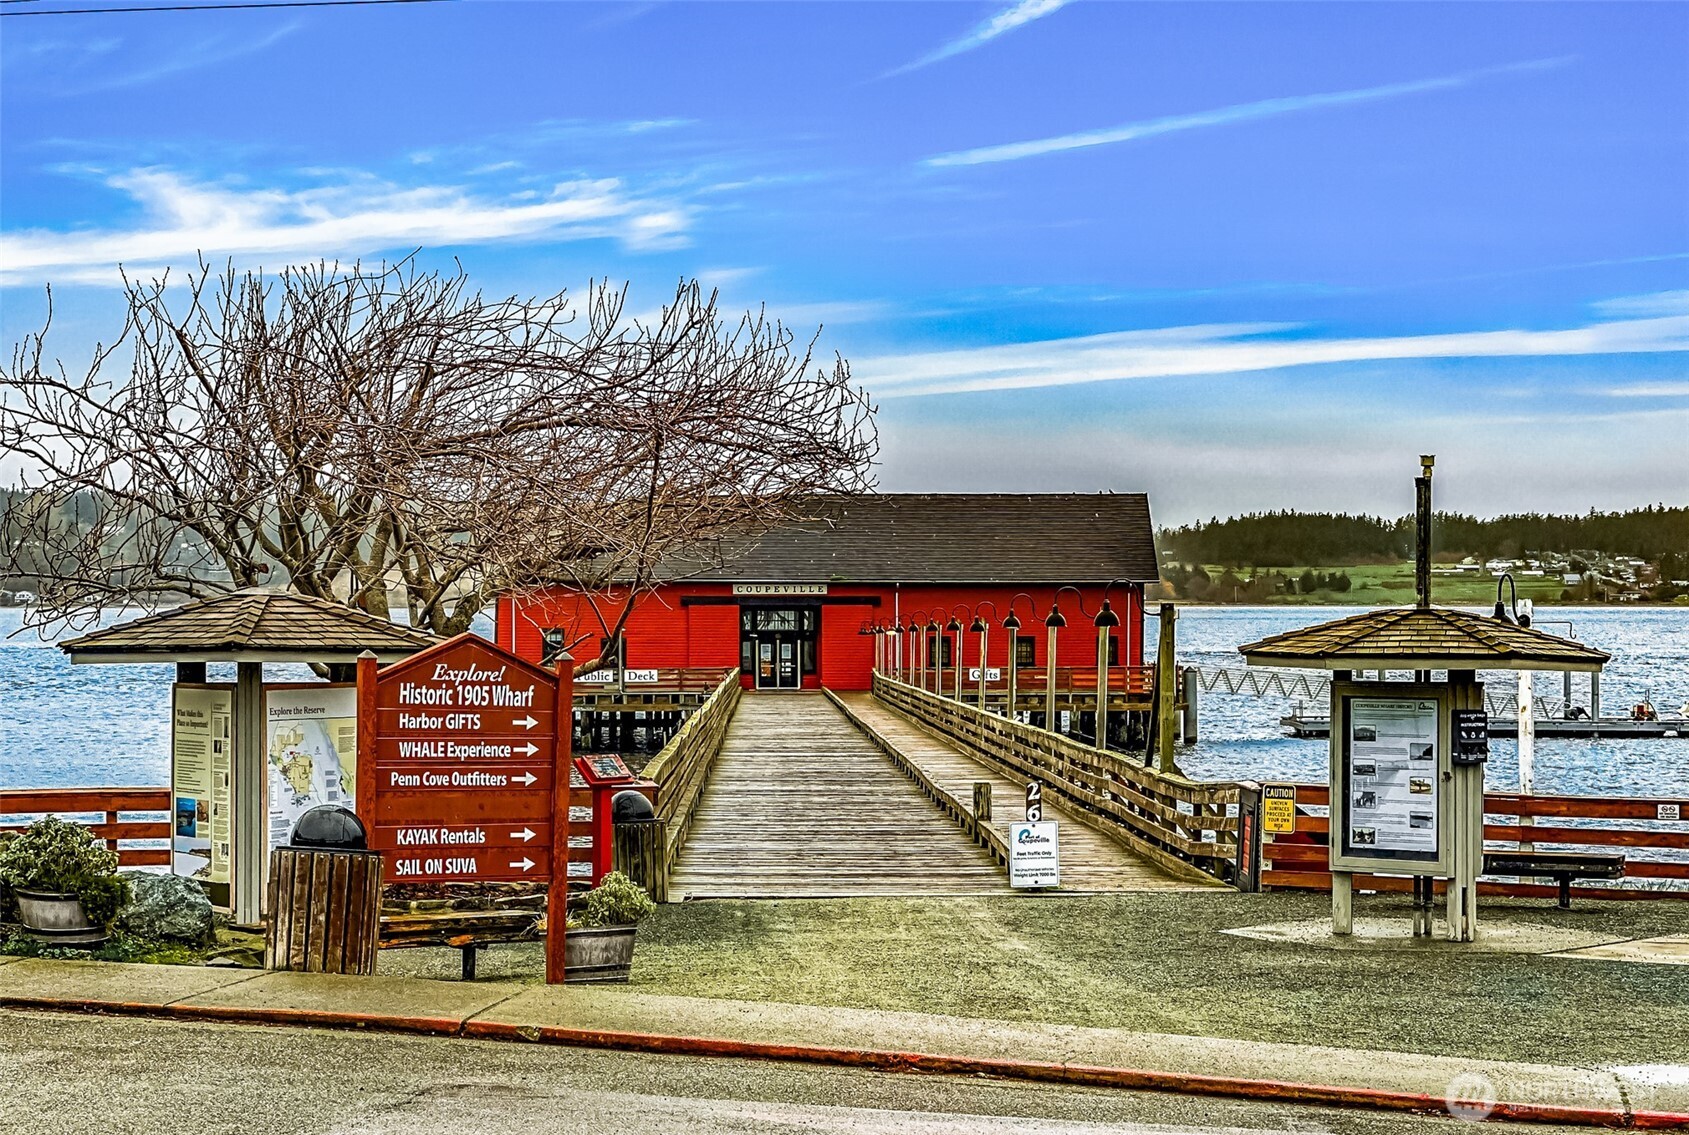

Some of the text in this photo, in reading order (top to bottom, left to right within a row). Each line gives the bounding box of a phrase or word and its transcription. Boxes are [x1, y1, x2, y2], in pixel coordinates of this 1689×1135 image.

[736, 585, 824, 594] COUPEVILLE
[431, 663, 506, 686] Explore!
[628, 670, 655, 681] Deck
[972, 669, 998, 680] Gfts
[399, 682, 534, 707] Historic 1905 Wharf
[269, 706, 325, 718] Explore the Reserve
[399, 713, 480, 730] Harbor GIFTS
[399, 742, 511, 761] WHALE Experience
[391, 771, 507, 786] Penn Cove Outfitters
[1266, 788, 1293, 798] CAUTION
[397, 828, 485, 844] KAYAK Rentals
[396, 858, 477, 875] SAIL ON SUVA
